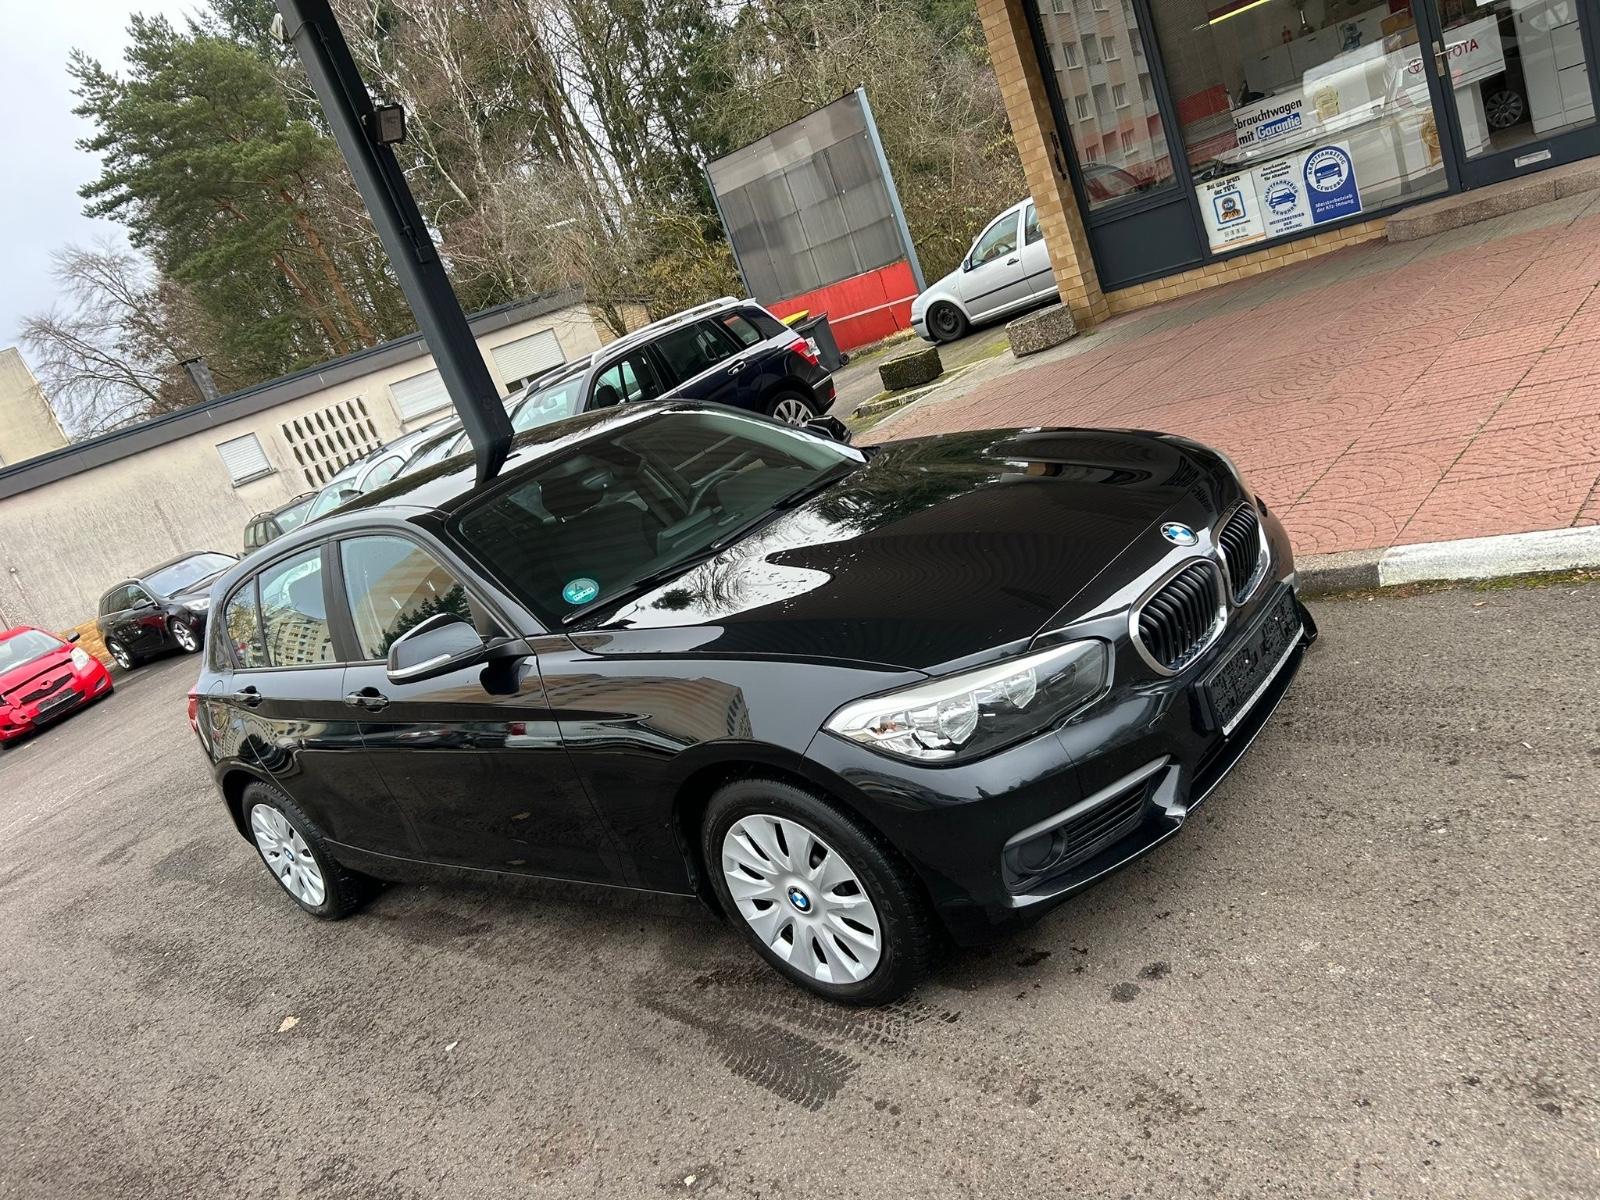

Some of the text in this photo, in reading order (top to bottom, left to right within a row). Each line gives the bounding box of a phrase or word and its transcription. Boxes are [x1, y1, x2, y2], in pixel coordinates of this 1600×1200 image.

[1239, 131, 1254, 145] mit
[1257, 114, 1301, 138] Garantie
[1308, 151, 1346, 175] KRAFTFAHRZEUG
[1317, 178, 1343, 191] GEWERBE
[1315, 194, 1353, 207] Meisterbetrieb
